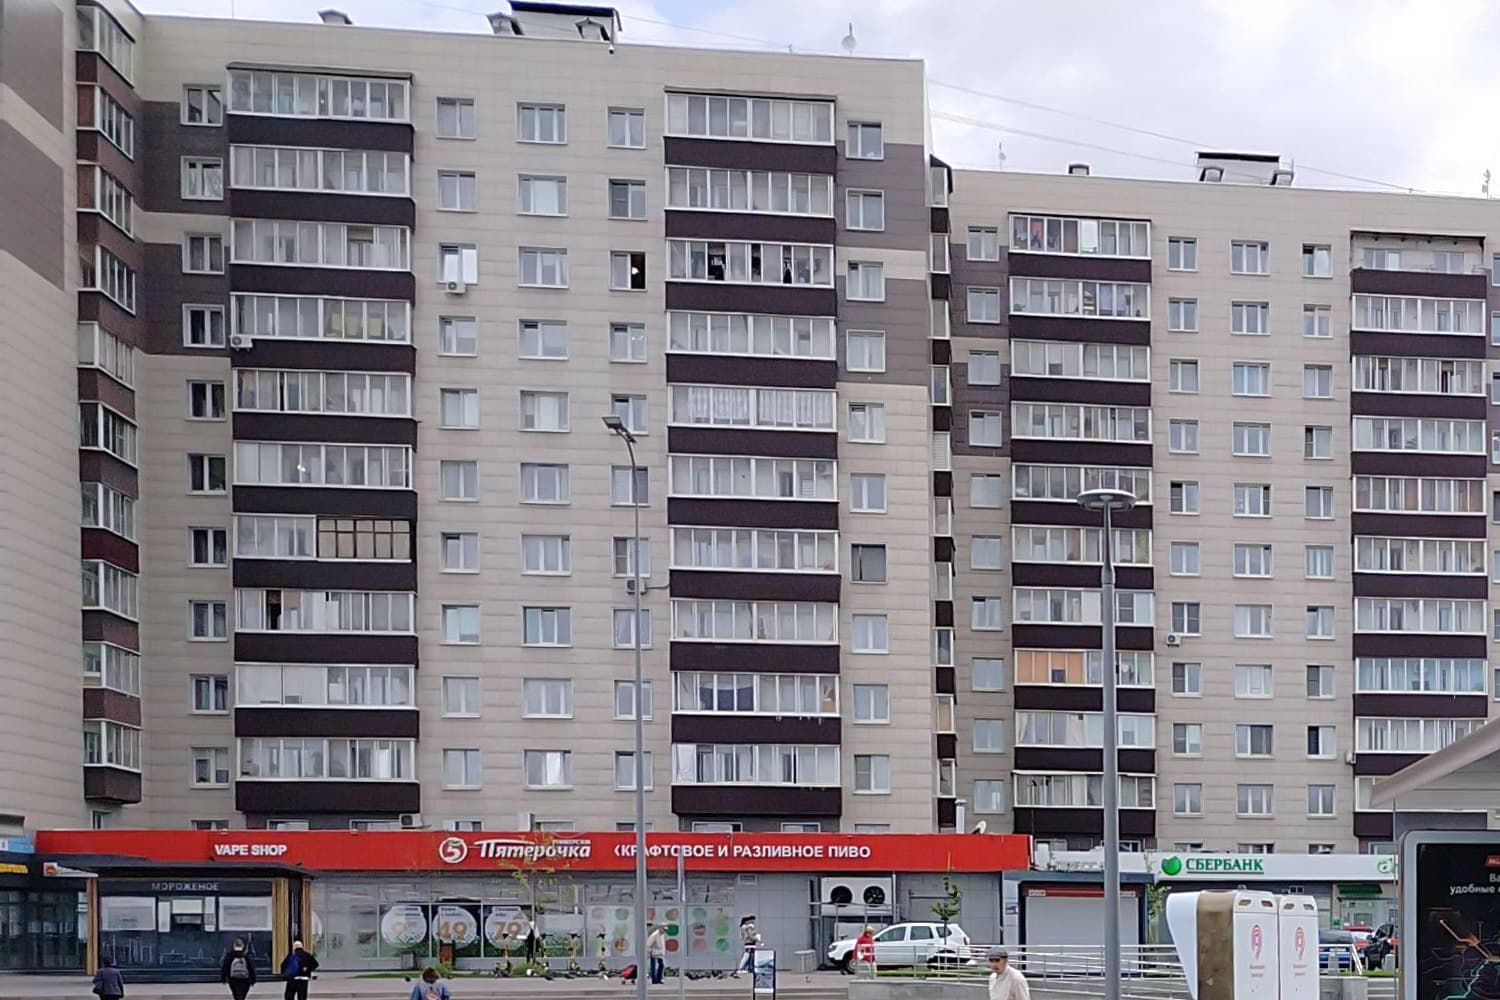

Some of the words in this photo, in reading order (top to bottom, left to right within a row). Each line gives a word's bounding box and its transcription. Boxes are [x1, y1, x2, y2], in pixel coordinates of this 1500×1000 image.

[214, 844, 249, 856] VAPE
[250, 844, 288, 856] SHOP
[474, 838, 591, 861] Пятерочка
[718, 845, 728, 857] И
[733, 845, 823, 858] РАЗЛИВНОЕ
[828, 846, 871, 858] ПИВО
[1186, 858, 1263, 871] СБЕРБАНК
[151, 882, 219, 891] МОРОЖЕНОЕ
[1449, 883, 1496, 895] удобные
